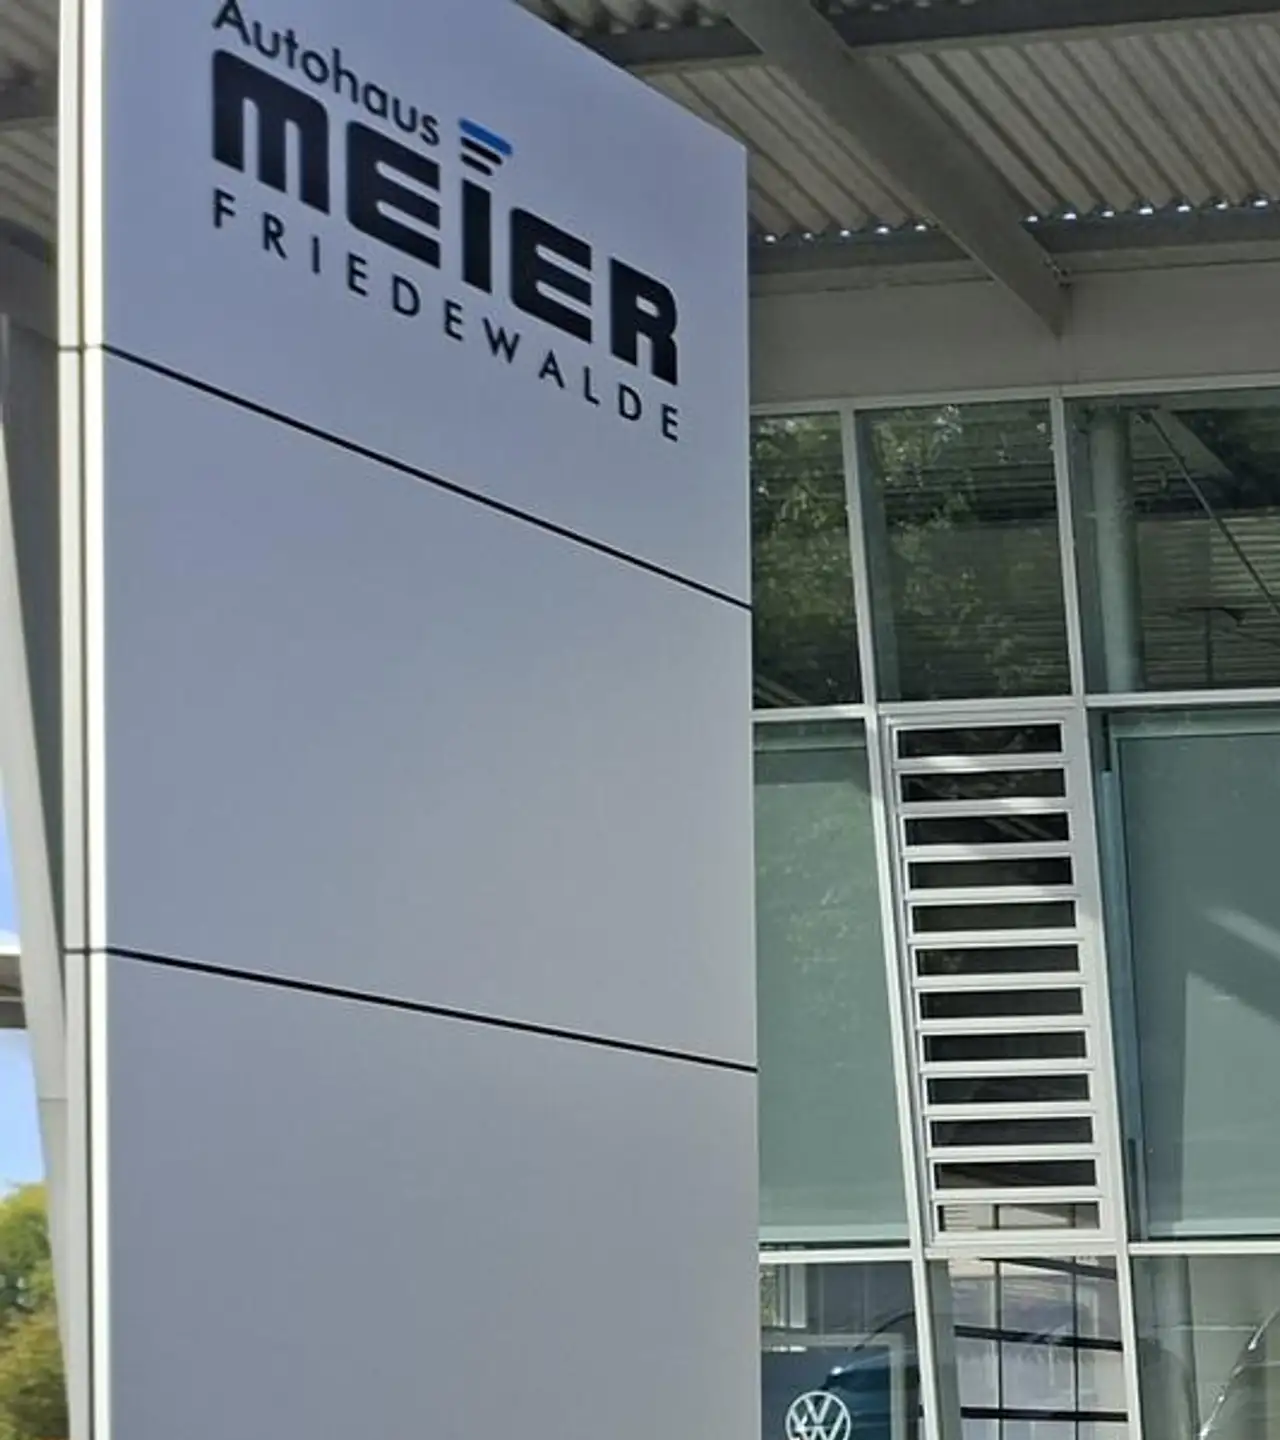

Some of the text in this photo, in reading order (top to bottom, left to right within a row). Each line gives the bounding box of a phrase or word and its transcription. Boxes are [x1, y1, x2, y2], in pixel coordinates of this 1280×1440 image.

[212, 0, 440, 146] Autohaus
[212, 49, 678, 386] MEIER
[212, 189, 679, 442] FRIEDEWALDE
